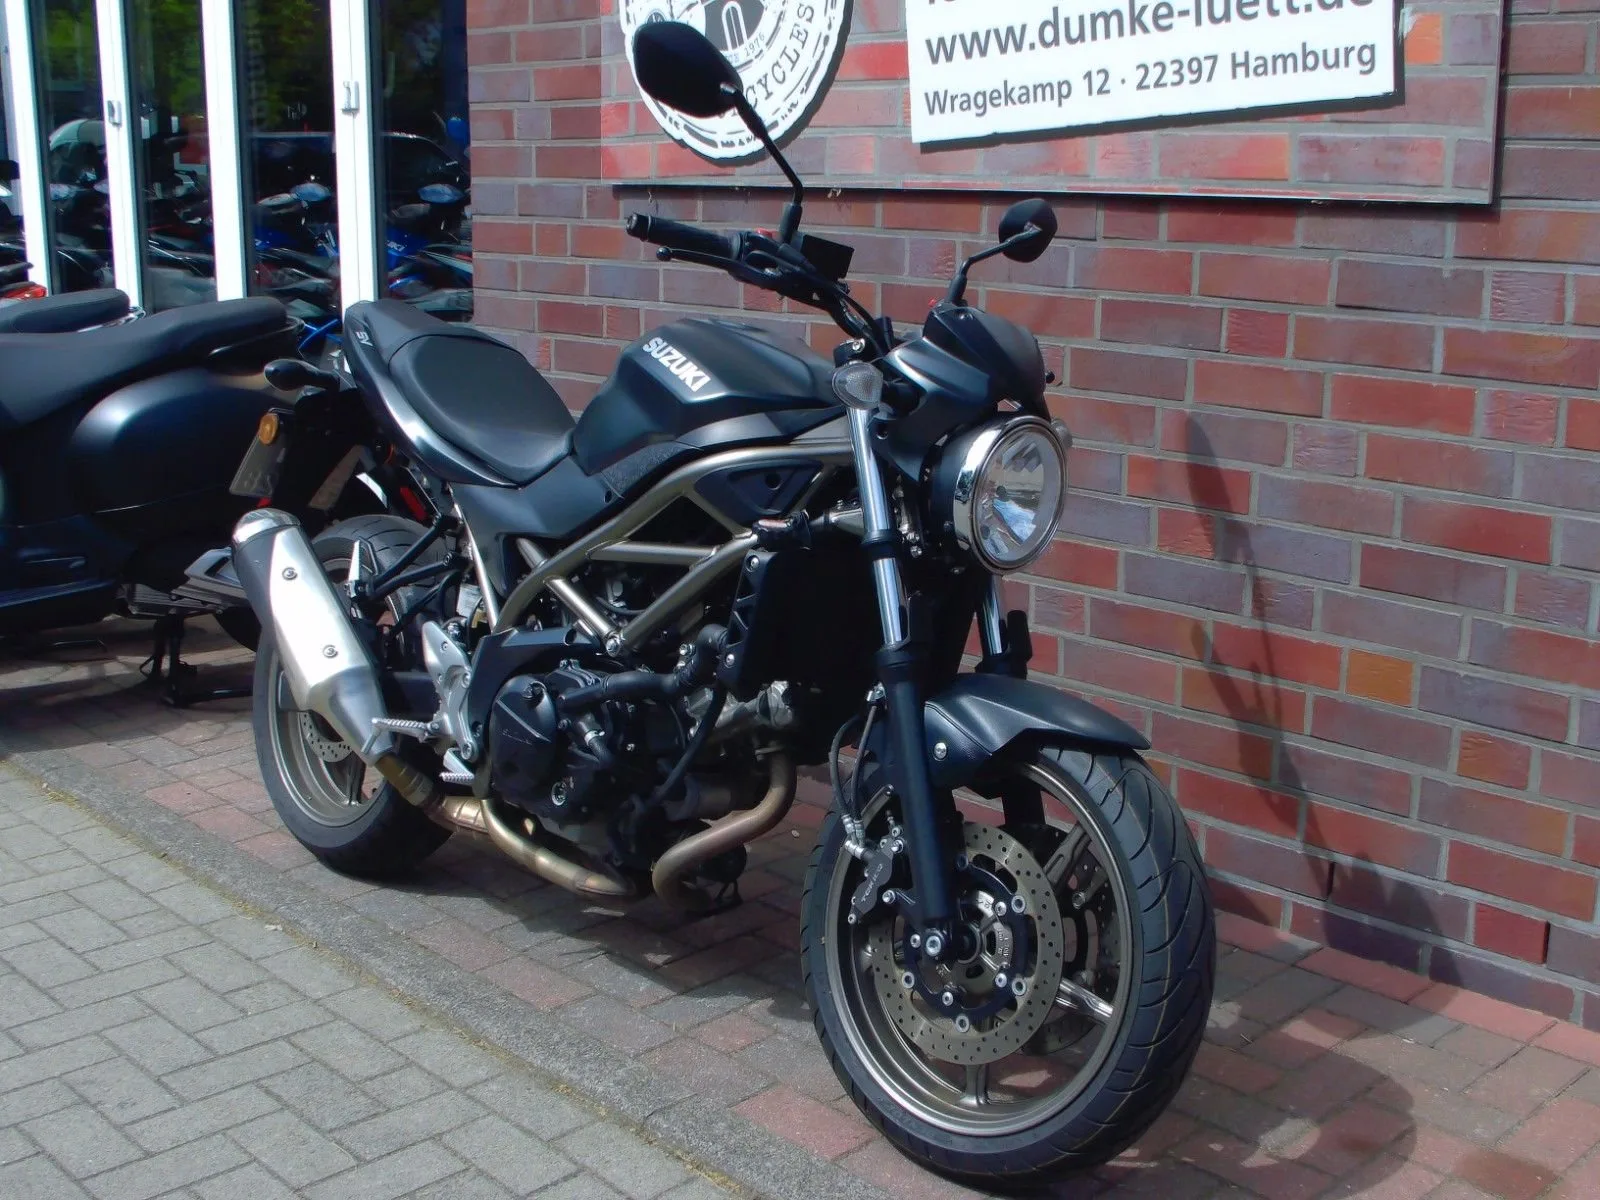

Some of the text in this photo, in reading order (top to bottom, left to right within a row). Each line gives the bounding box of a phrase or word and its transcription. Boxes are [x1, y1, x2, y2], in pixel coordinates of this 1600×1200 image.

[722, 3, 814, 116] CYCLES
[925, 0, 1373, 65] www.dumke-lue.
[924, 42, 1377, 117] Wragekamp 12 22397 Hamburg
[643, 336, 711, 392] SUZUKI
